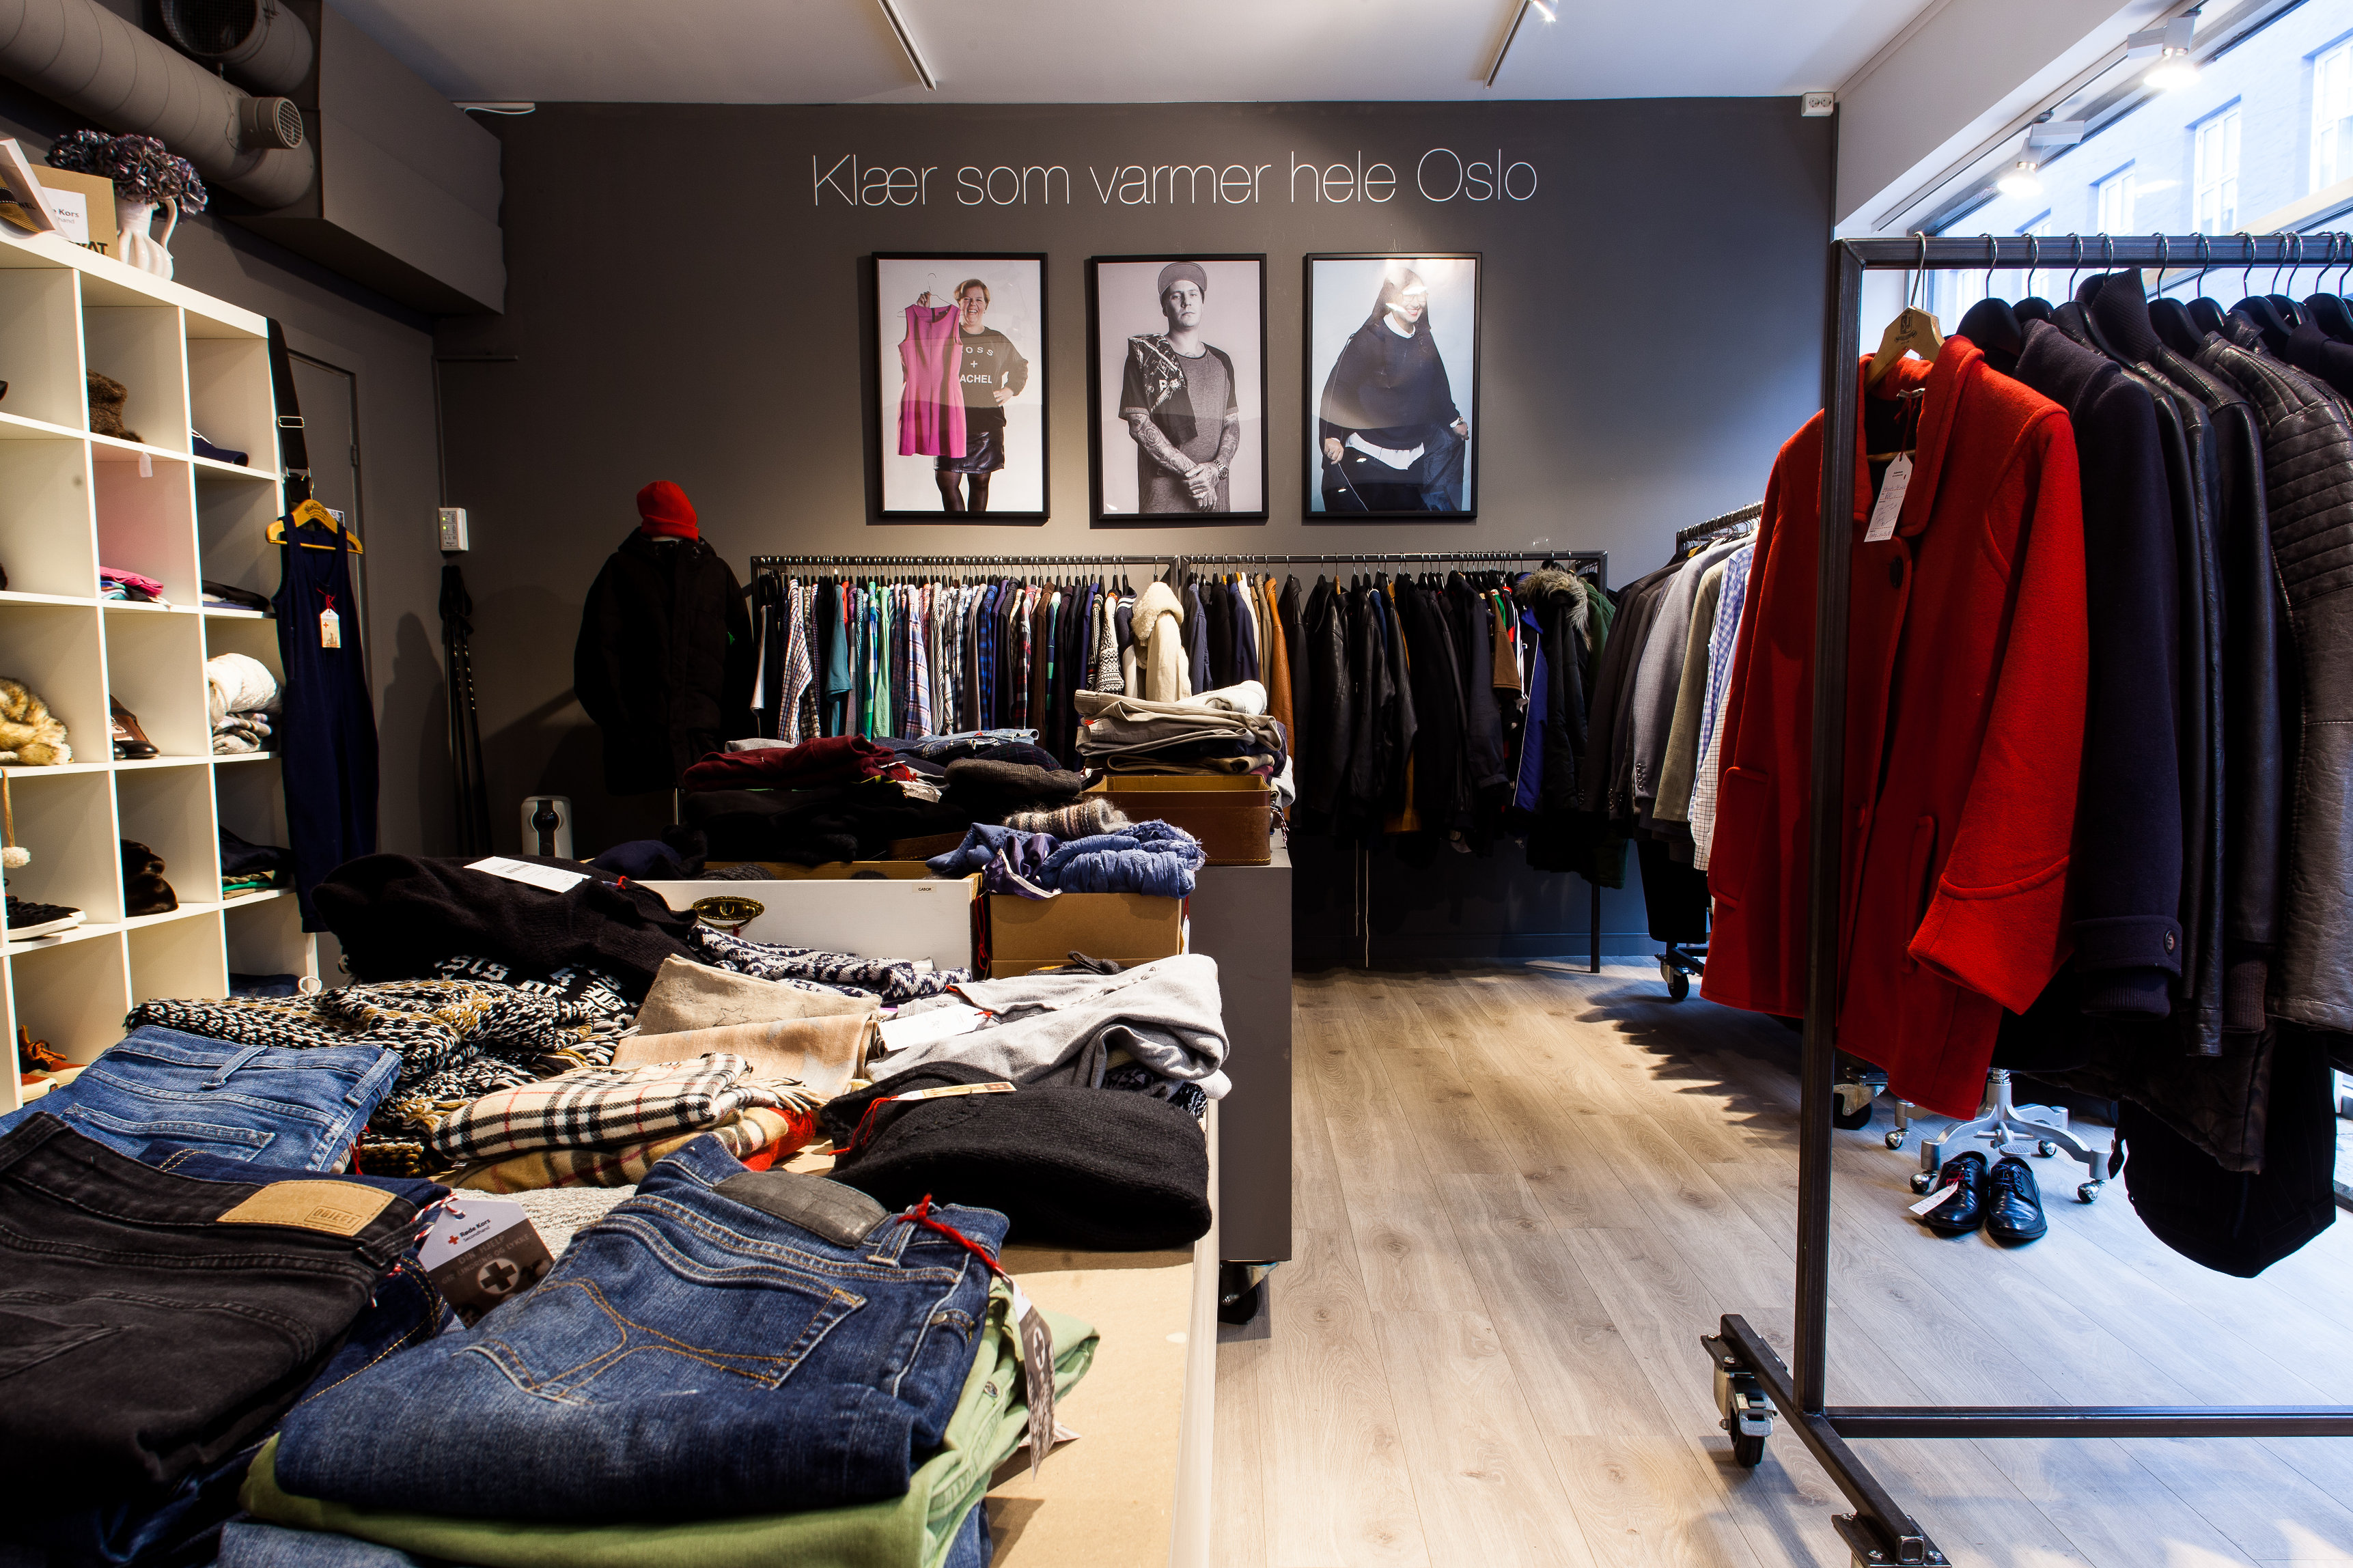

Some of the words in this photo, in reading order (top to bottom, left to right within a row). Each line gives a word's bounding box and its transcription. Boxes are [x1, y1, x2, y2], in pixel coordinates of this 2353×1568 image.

[813, 154, 937, 206] Klær
[957, 166, 1069, 205] som
[1089, 165, 1271, 204] varmer
[1292, 150, 1395, 203] hele
[1418, 148, 1537, 201] Oslo
[59, 208, 80, 218] Kors
[961, 346, 994, 356] OSS
[314, 1209, 357, 1224] OBJECT
[460, 1227, 476, 1237] Røde
[476, 1219, 490, 1229] Kors
[463, 1226, 490, 1242] Secondhand
[458, 1251, 476, 1264] DIN
[479, 1235, 505, 1253] HJELP
[494, 1246, 505, 1256] OG
